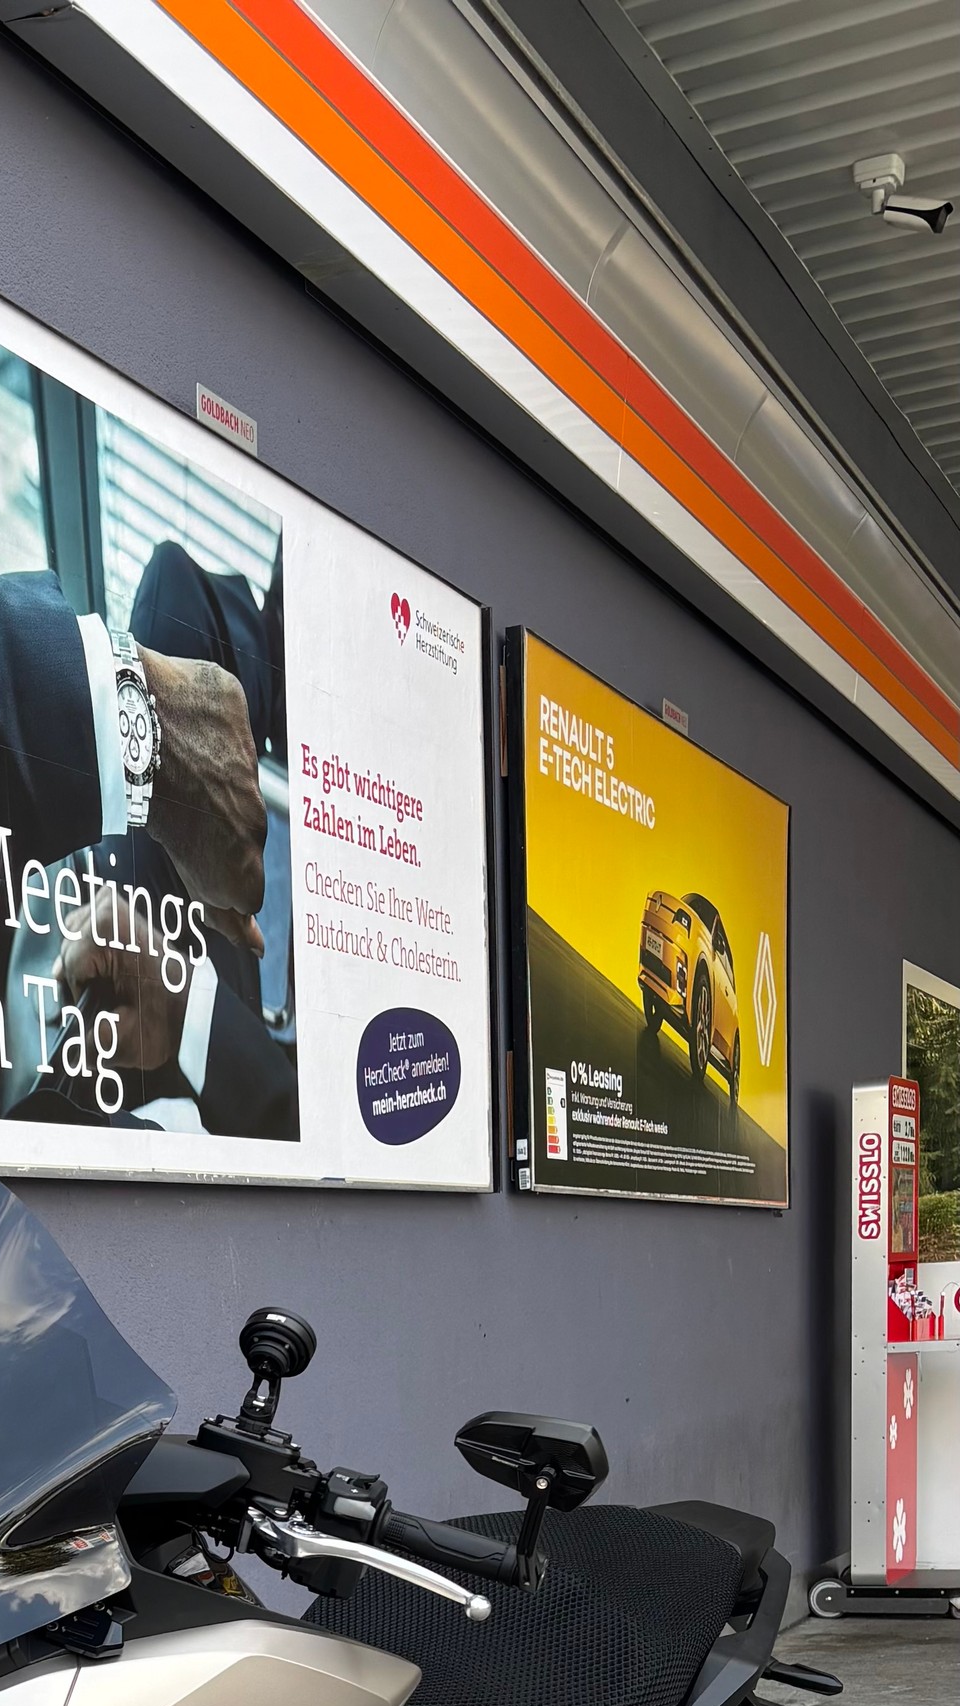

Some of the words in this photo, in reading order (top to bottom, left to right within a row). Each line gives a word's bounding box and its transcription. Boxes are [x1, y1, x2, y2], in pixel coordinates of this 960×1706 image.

[201, 394, 239, 434] GOLDBACH
[240, 420, 254, 443] NEO
[415, 609, 465, 654] Schweizerische
[415, 633, 458, 675] Herzstiftung
[540, 694, 604, 764] RENAULT
[606, 735, 614, 770] 5
[301, 743, 318, 779] Es
[322, 754, 350, 795] gibt
[354, 770, 423, 823] wichtigere
[540, 736, 592, 798] E-TECH
[595, 767, 655, 830] ELECTRIC
[303, 796, 354, 844] Zahlen
[357, 815, 376, 852] im
[379, 824, 421, 868] Leben.
[304, 861, 363, 908] Checken
[367, 881, 385, 915] Sie
[388, 888, 413, 923] Ihre
[415, 897, 454, 935] Werte.
[306, 913, 373, 960] Blutdruck
[376, 931, 389, 963] &
[391, 937, 462, 983] Cholesterin.
[23, 974, 124, 1114] Tag
[389, 1032, 406, 1053] Jetzt
[408, 1031, 425, 1049] zum
[411, 1053, 450, 1079] anmelden!
[372, 1081, 447, 1117] mein-herzcheck.ch
[589, 1064, 623, 1097] Leasing
